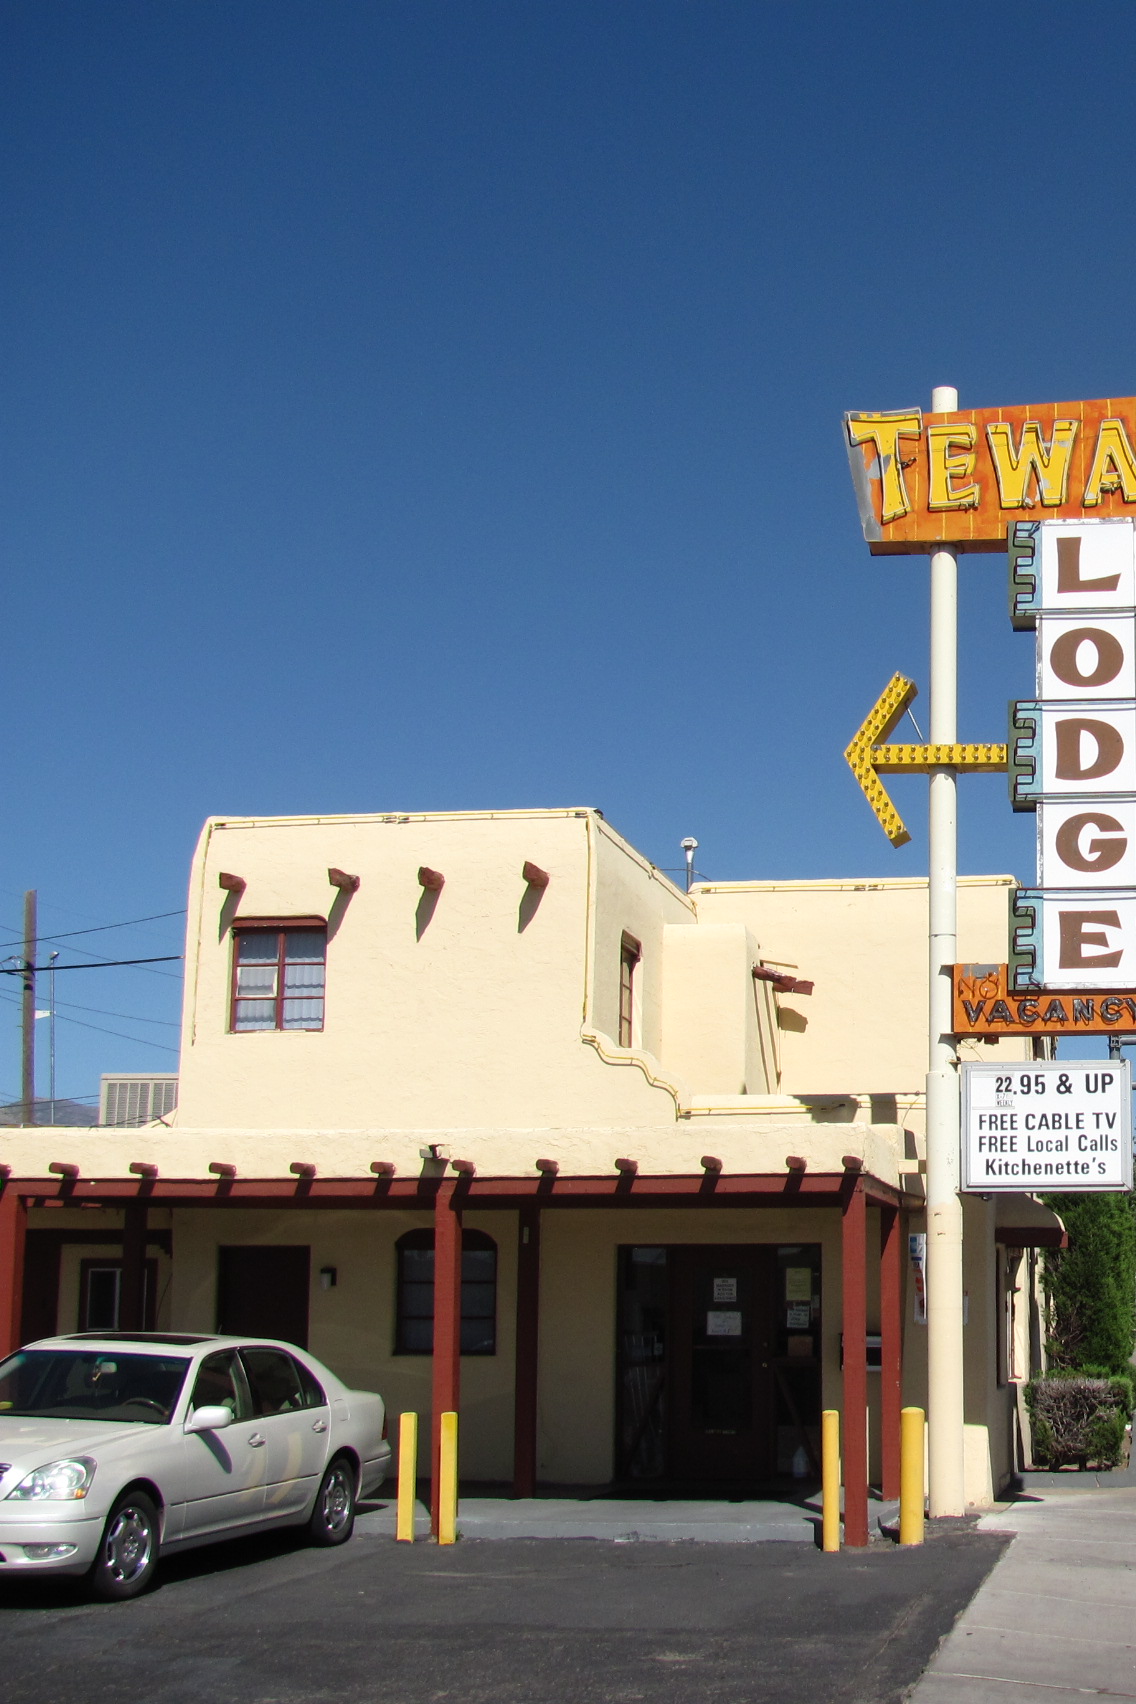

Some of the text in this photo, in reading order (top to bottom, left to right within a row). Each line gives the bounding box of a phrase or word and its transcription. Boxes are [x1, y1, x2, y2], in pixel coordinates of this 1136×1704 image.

[1050, 536, 1128, 969] LODGE
[995, 1073, 1114, 1095] 22.95 & UP
[978, 1112, 1117, 1131] FREE CABLE TV
[978, 1134, 1118, 1153] FREE Local Calls
[985, 1157, 1106, 1176] Kitchenette's
